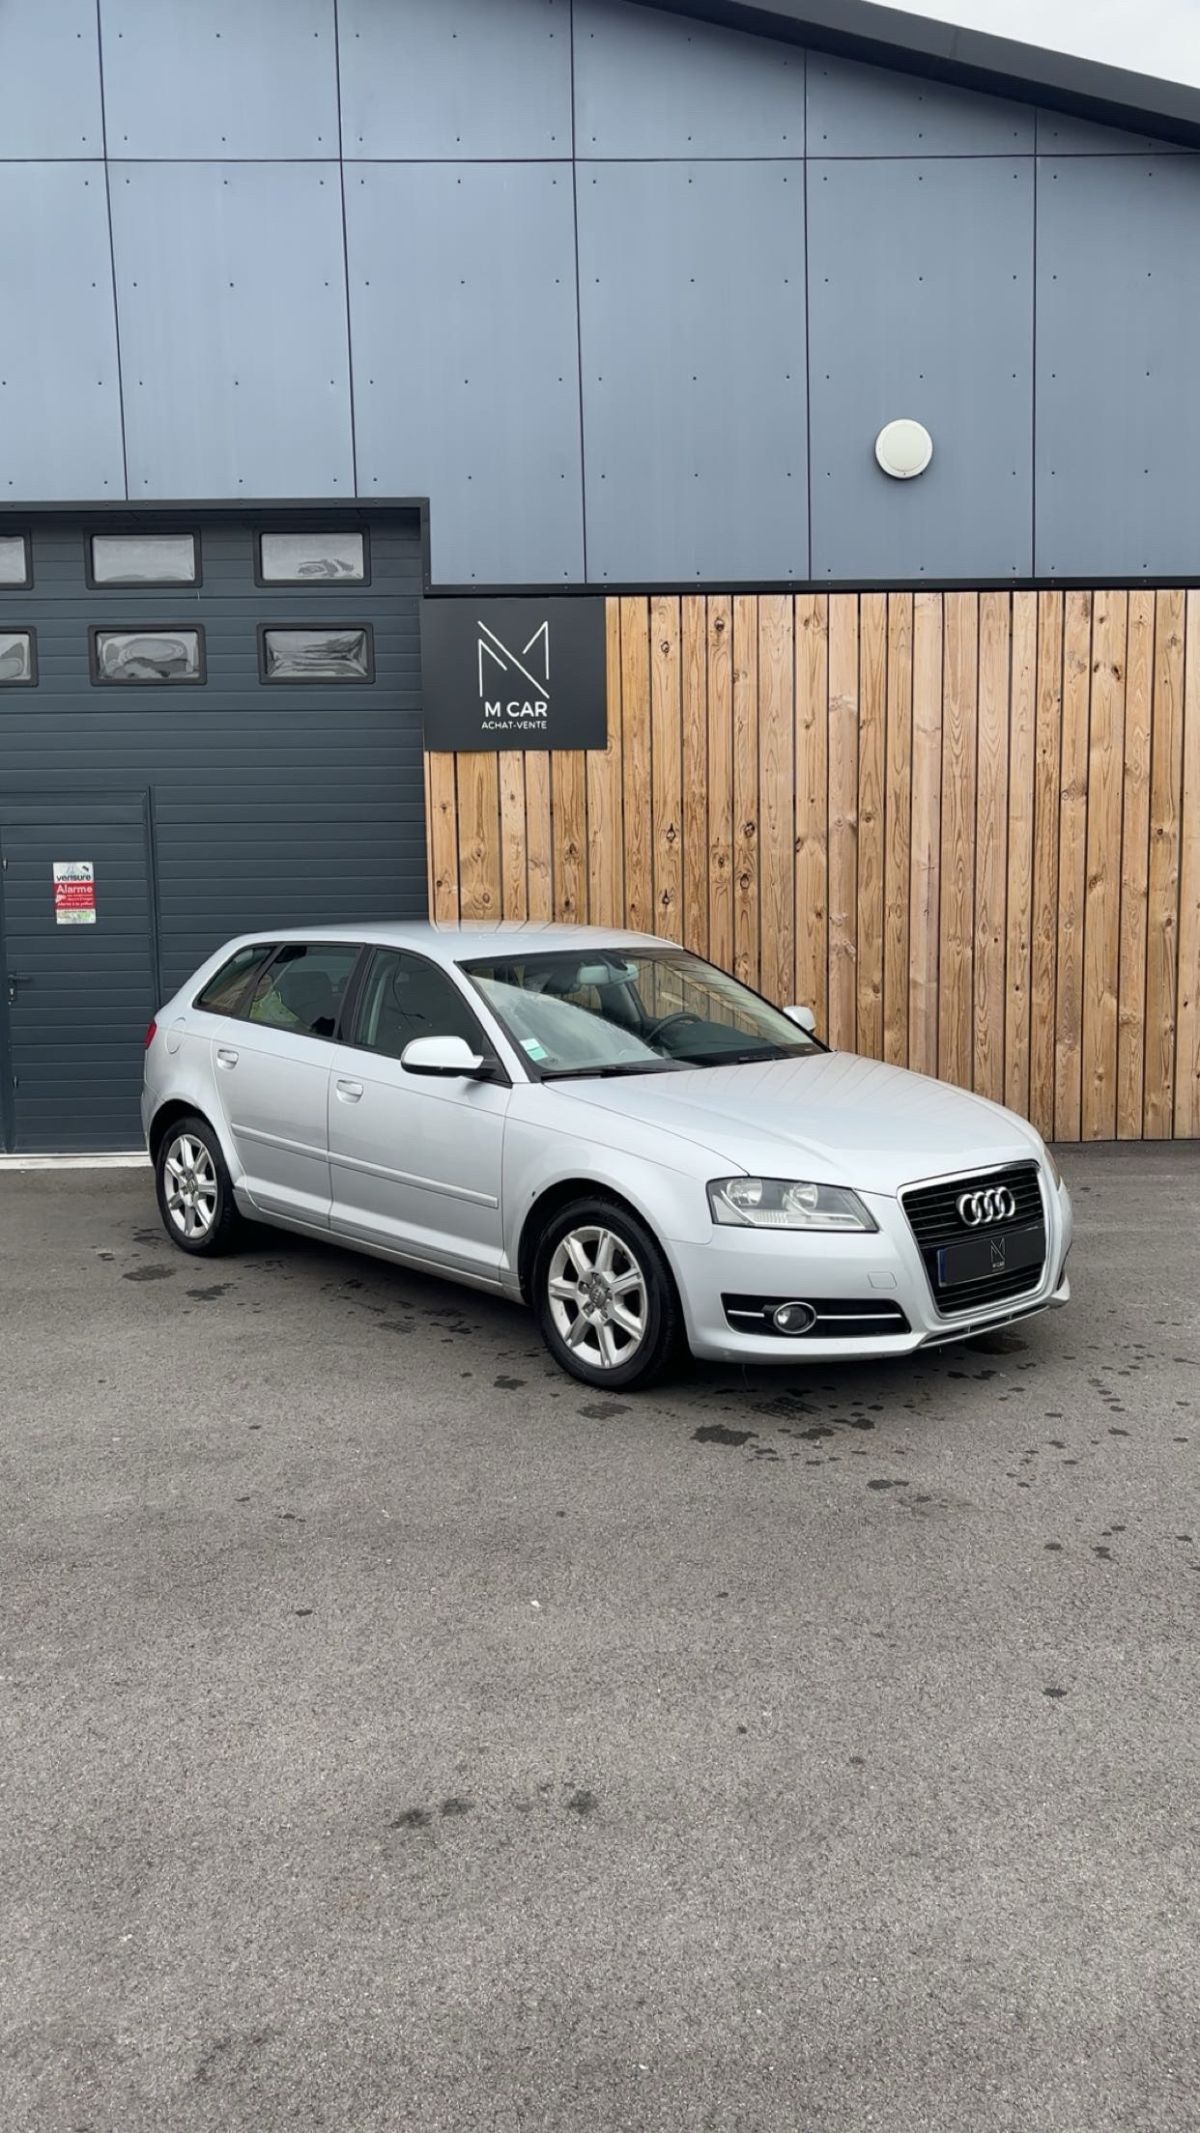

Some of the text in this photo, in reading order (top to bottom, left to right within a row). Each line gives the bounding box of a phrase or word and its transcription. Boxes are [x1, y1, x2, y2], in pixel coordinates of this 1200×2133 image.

[484, 701, 548, 717] M CAR
[481, 721, 547, 729] ACHAT-VENTE
[57, 884, 93, 893] Alarme
